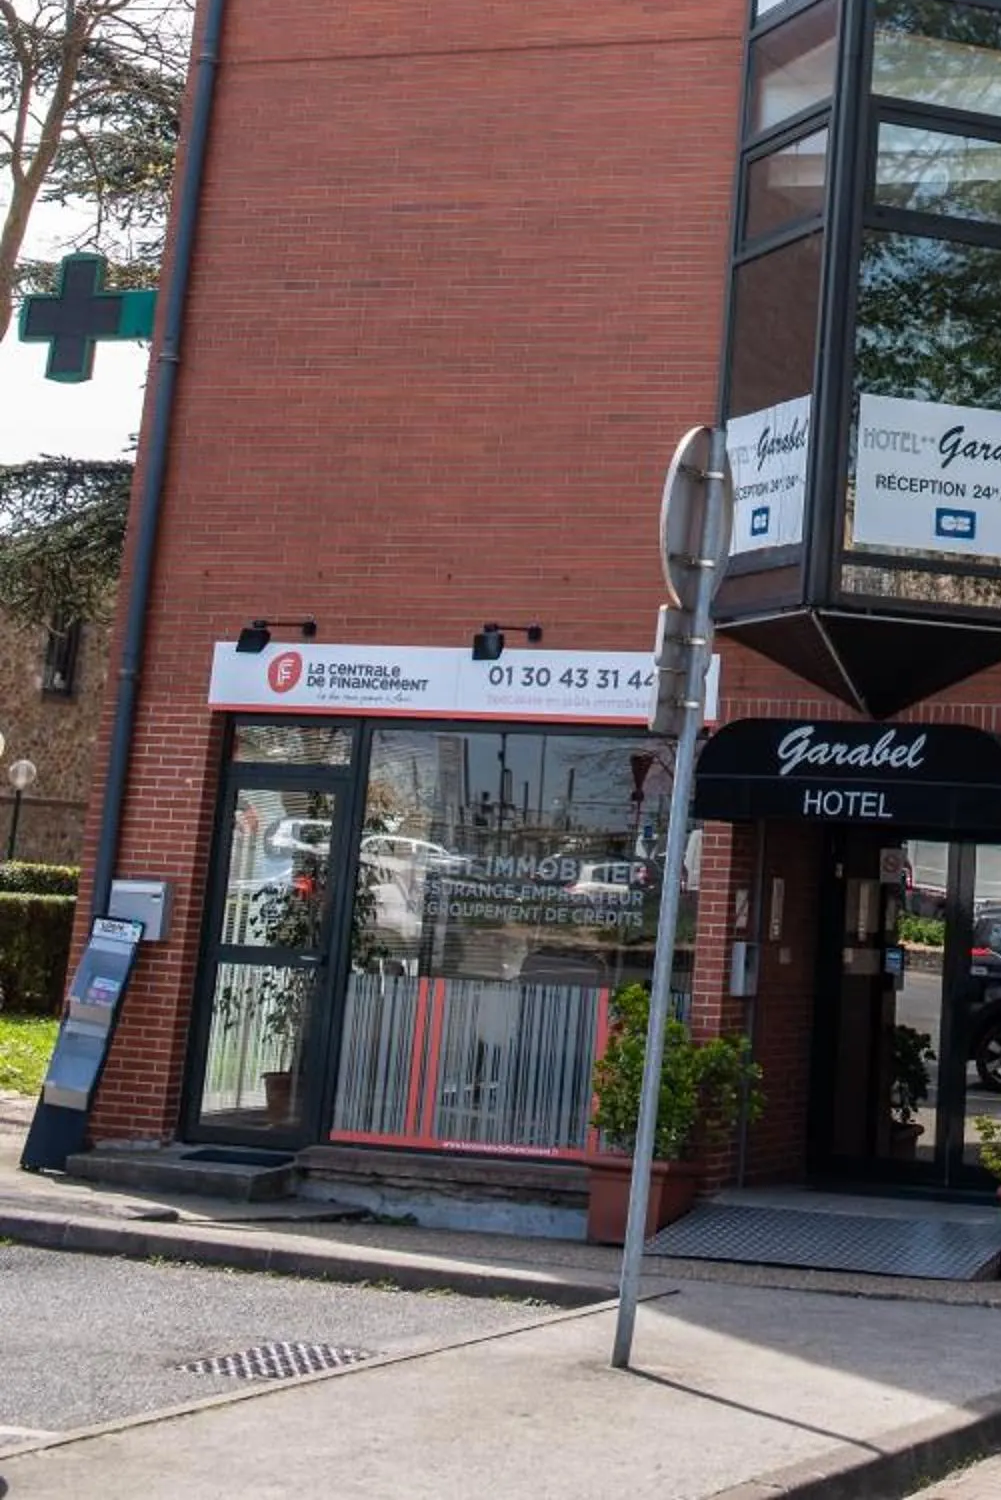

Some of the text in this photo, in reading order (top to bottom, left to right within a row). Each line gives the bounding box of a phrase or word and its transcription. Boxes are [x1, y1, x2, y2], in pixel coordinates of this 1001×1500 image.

[863, 427, 921, 454] HOTEL
[489, 666, 513, 686] 01
[521, 667, 550, 687] 30
[559, 668, 588, 689] 43
[596, 669, 619, 689] 31
[777, 725, 927, 776] Garabel
[803, 789, 893, 818] HOTEL
